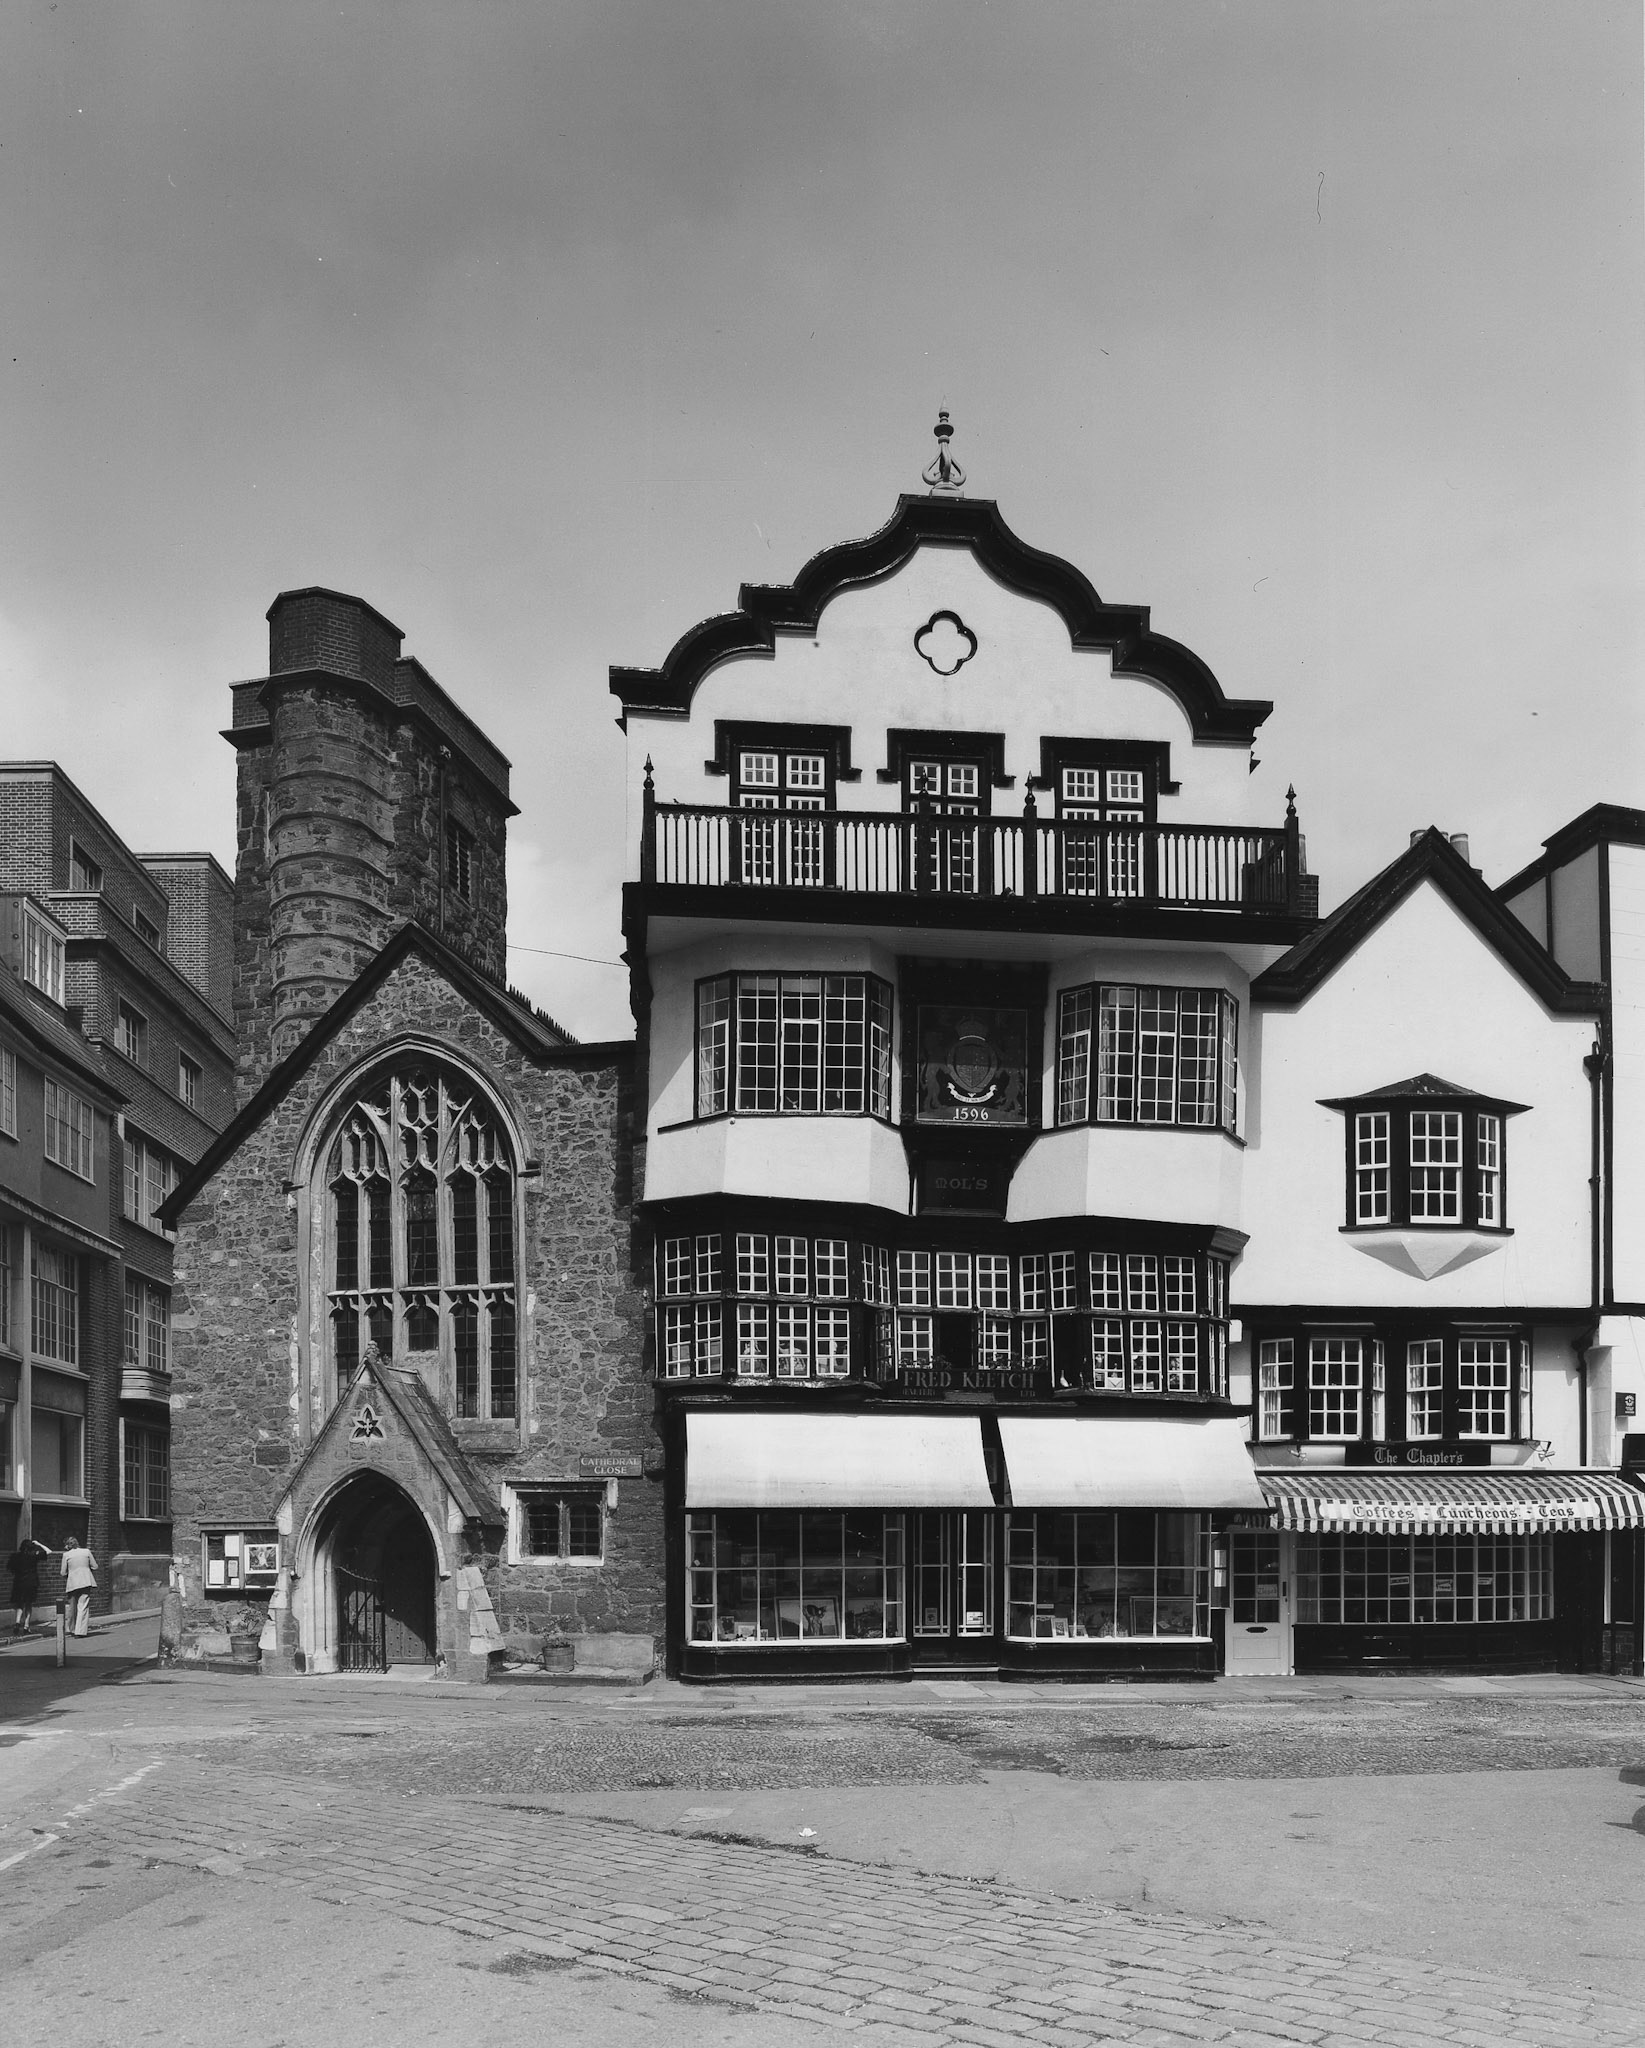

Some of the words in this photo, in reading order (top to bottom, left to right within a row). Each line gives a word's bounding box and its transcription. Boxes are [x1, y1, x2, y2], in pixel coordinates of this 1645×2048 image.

[953, 1108, 989, 1121] 1596
[935, 1177, 987, 1190] MOL'S
[904, 1371, 952, 1387] FRED
[963, 1371, 1034, 1388] KEETCH
[581, 1458, 639, 1466] CATHEDRAL
[1374, 1446, 1398, 1466] The
[1406, 1447, 1464, 1466] Chapter's
[594, 1466, 627, 1474] CLOSE
[1352, 1505, 1415, 1519] Coffees
[1538, 1504, 1575, 1517] Teas
